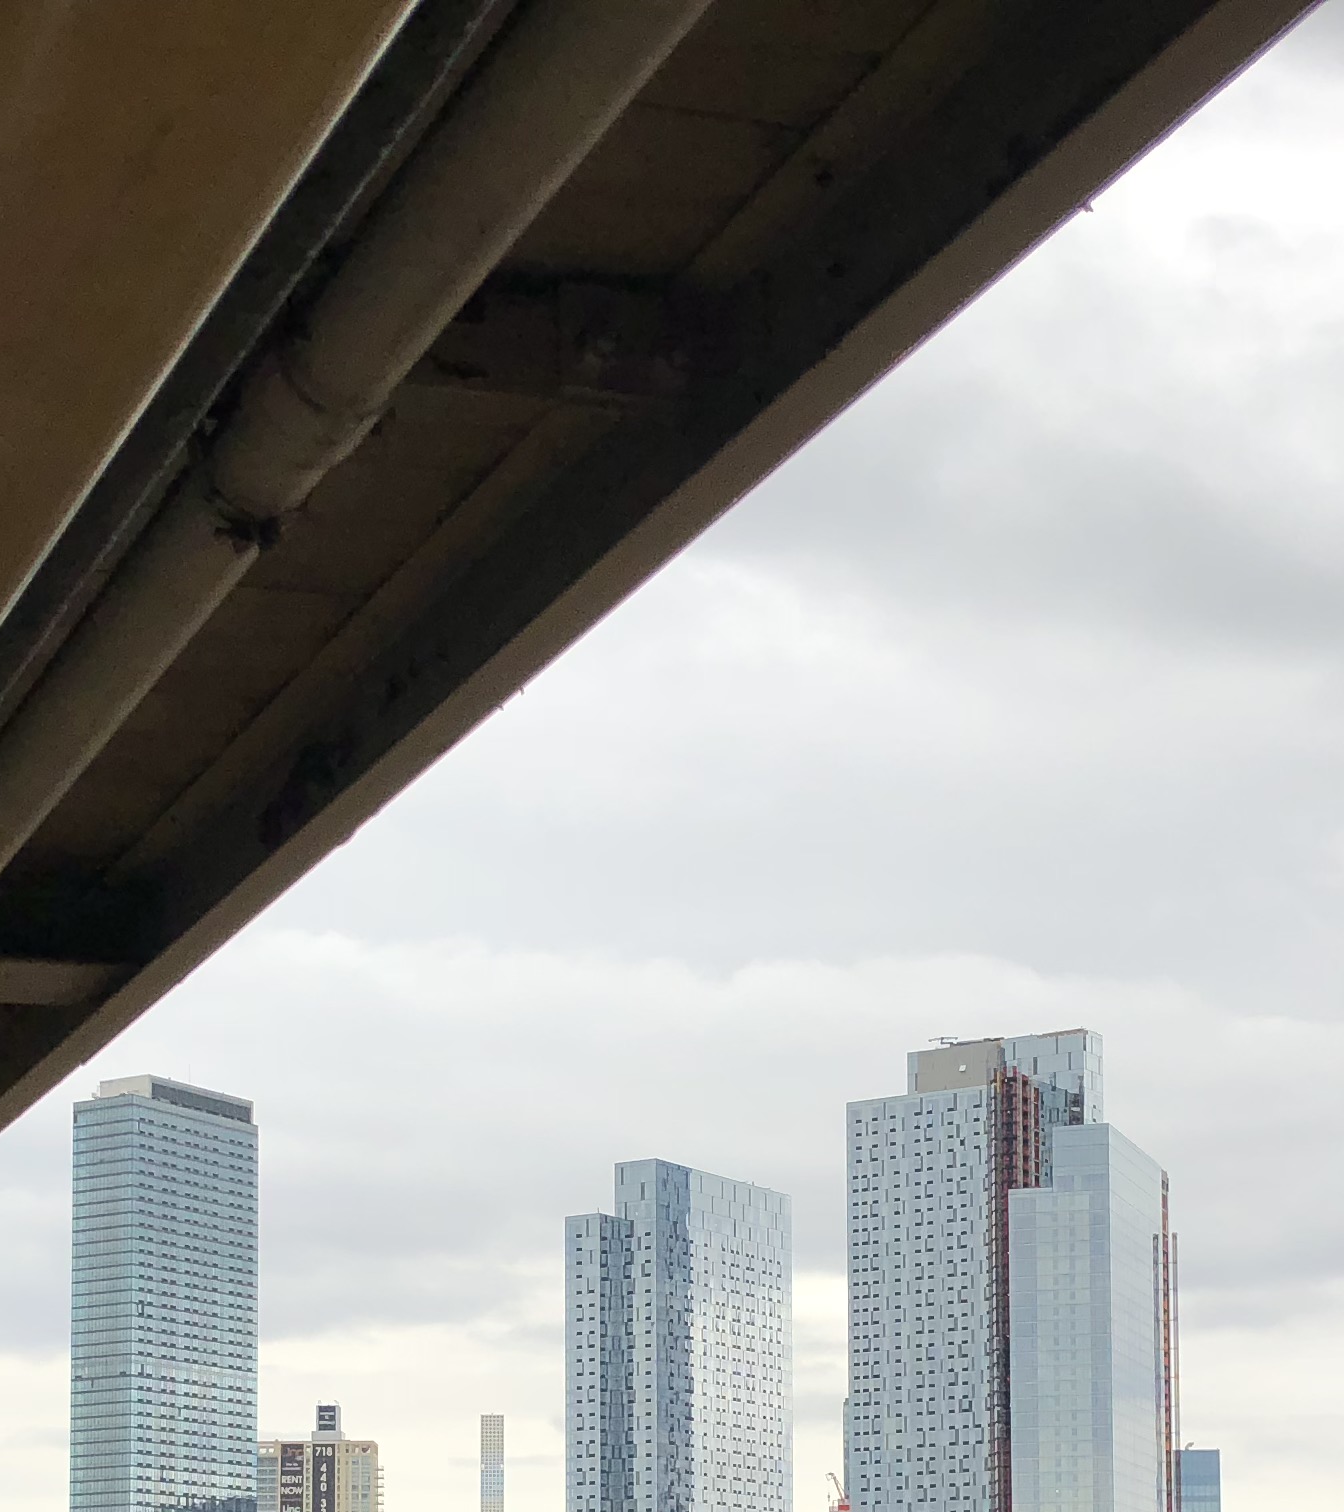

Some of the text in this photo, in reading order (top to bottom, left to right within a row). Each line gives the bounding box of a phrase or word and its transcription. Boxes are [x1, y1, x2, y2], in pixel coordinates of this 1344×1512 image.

[315, 1446, 333, 1457] 718
[281, 1475, 303, 1484] RENT
[280, 1486, 303, 1495] NOW
